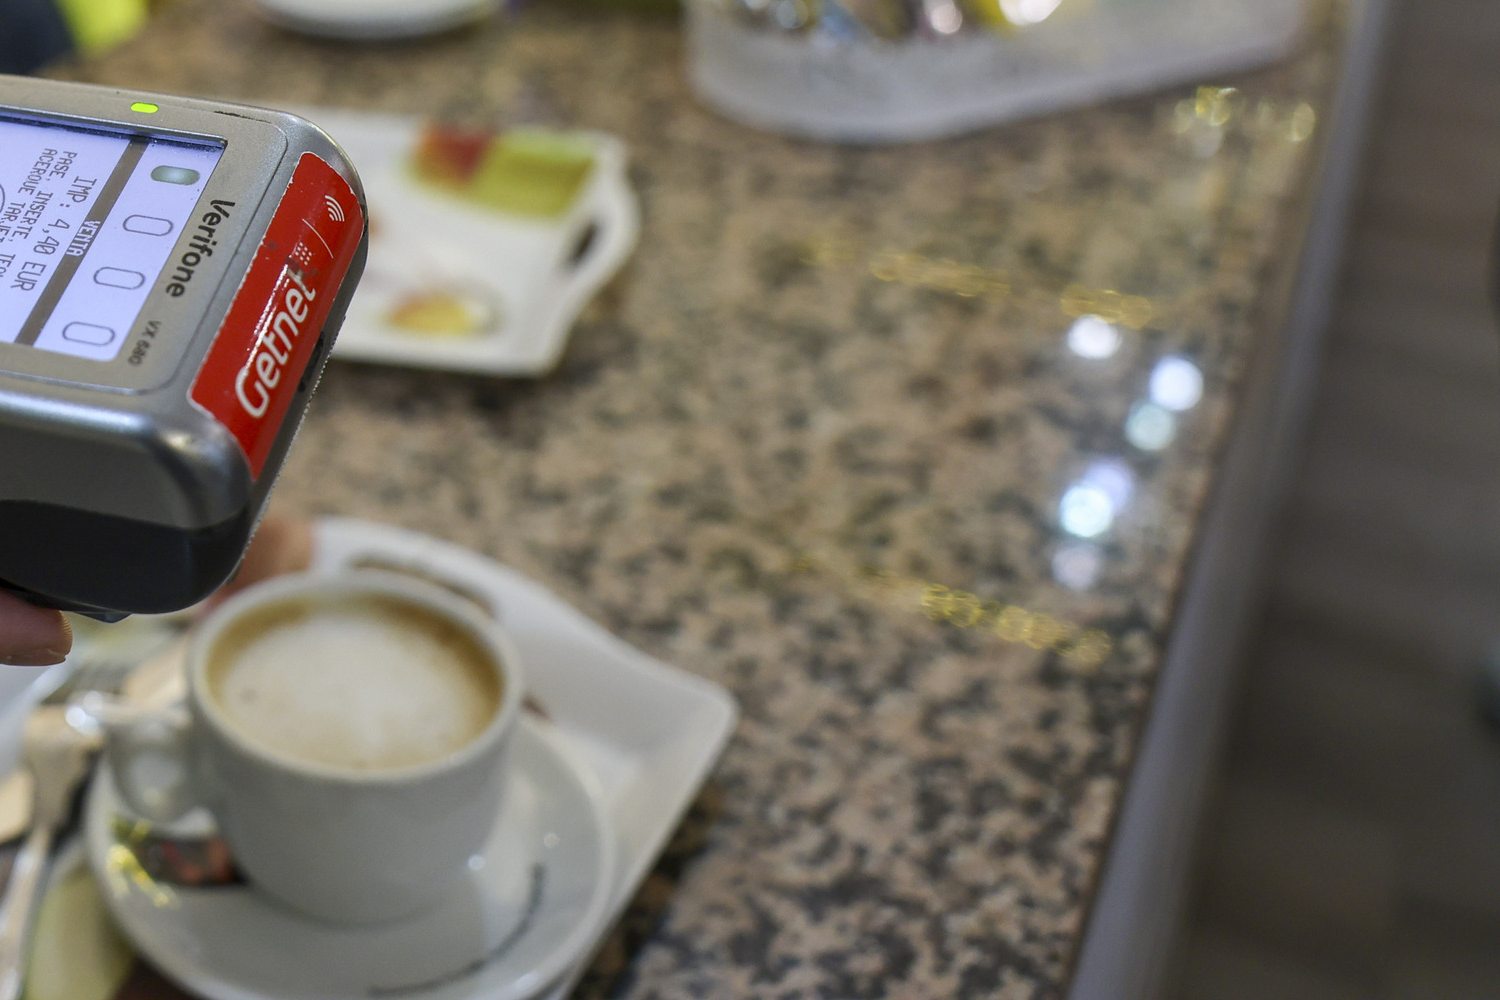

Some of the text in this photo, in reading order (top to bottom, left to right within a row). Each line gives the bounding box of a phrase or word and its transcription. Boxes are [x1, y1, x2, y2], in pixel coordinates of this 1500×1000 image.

[45, 150, 77, 182] PASE,
[10, 175, 97, 292] IMP: 4,40 EUR
[65, 219, 101, 257] VENTA
[165, 199, 236, 299] Verifone
[141, 319, 162, 339] VX
[234, 267, 316, 419] Getnet
